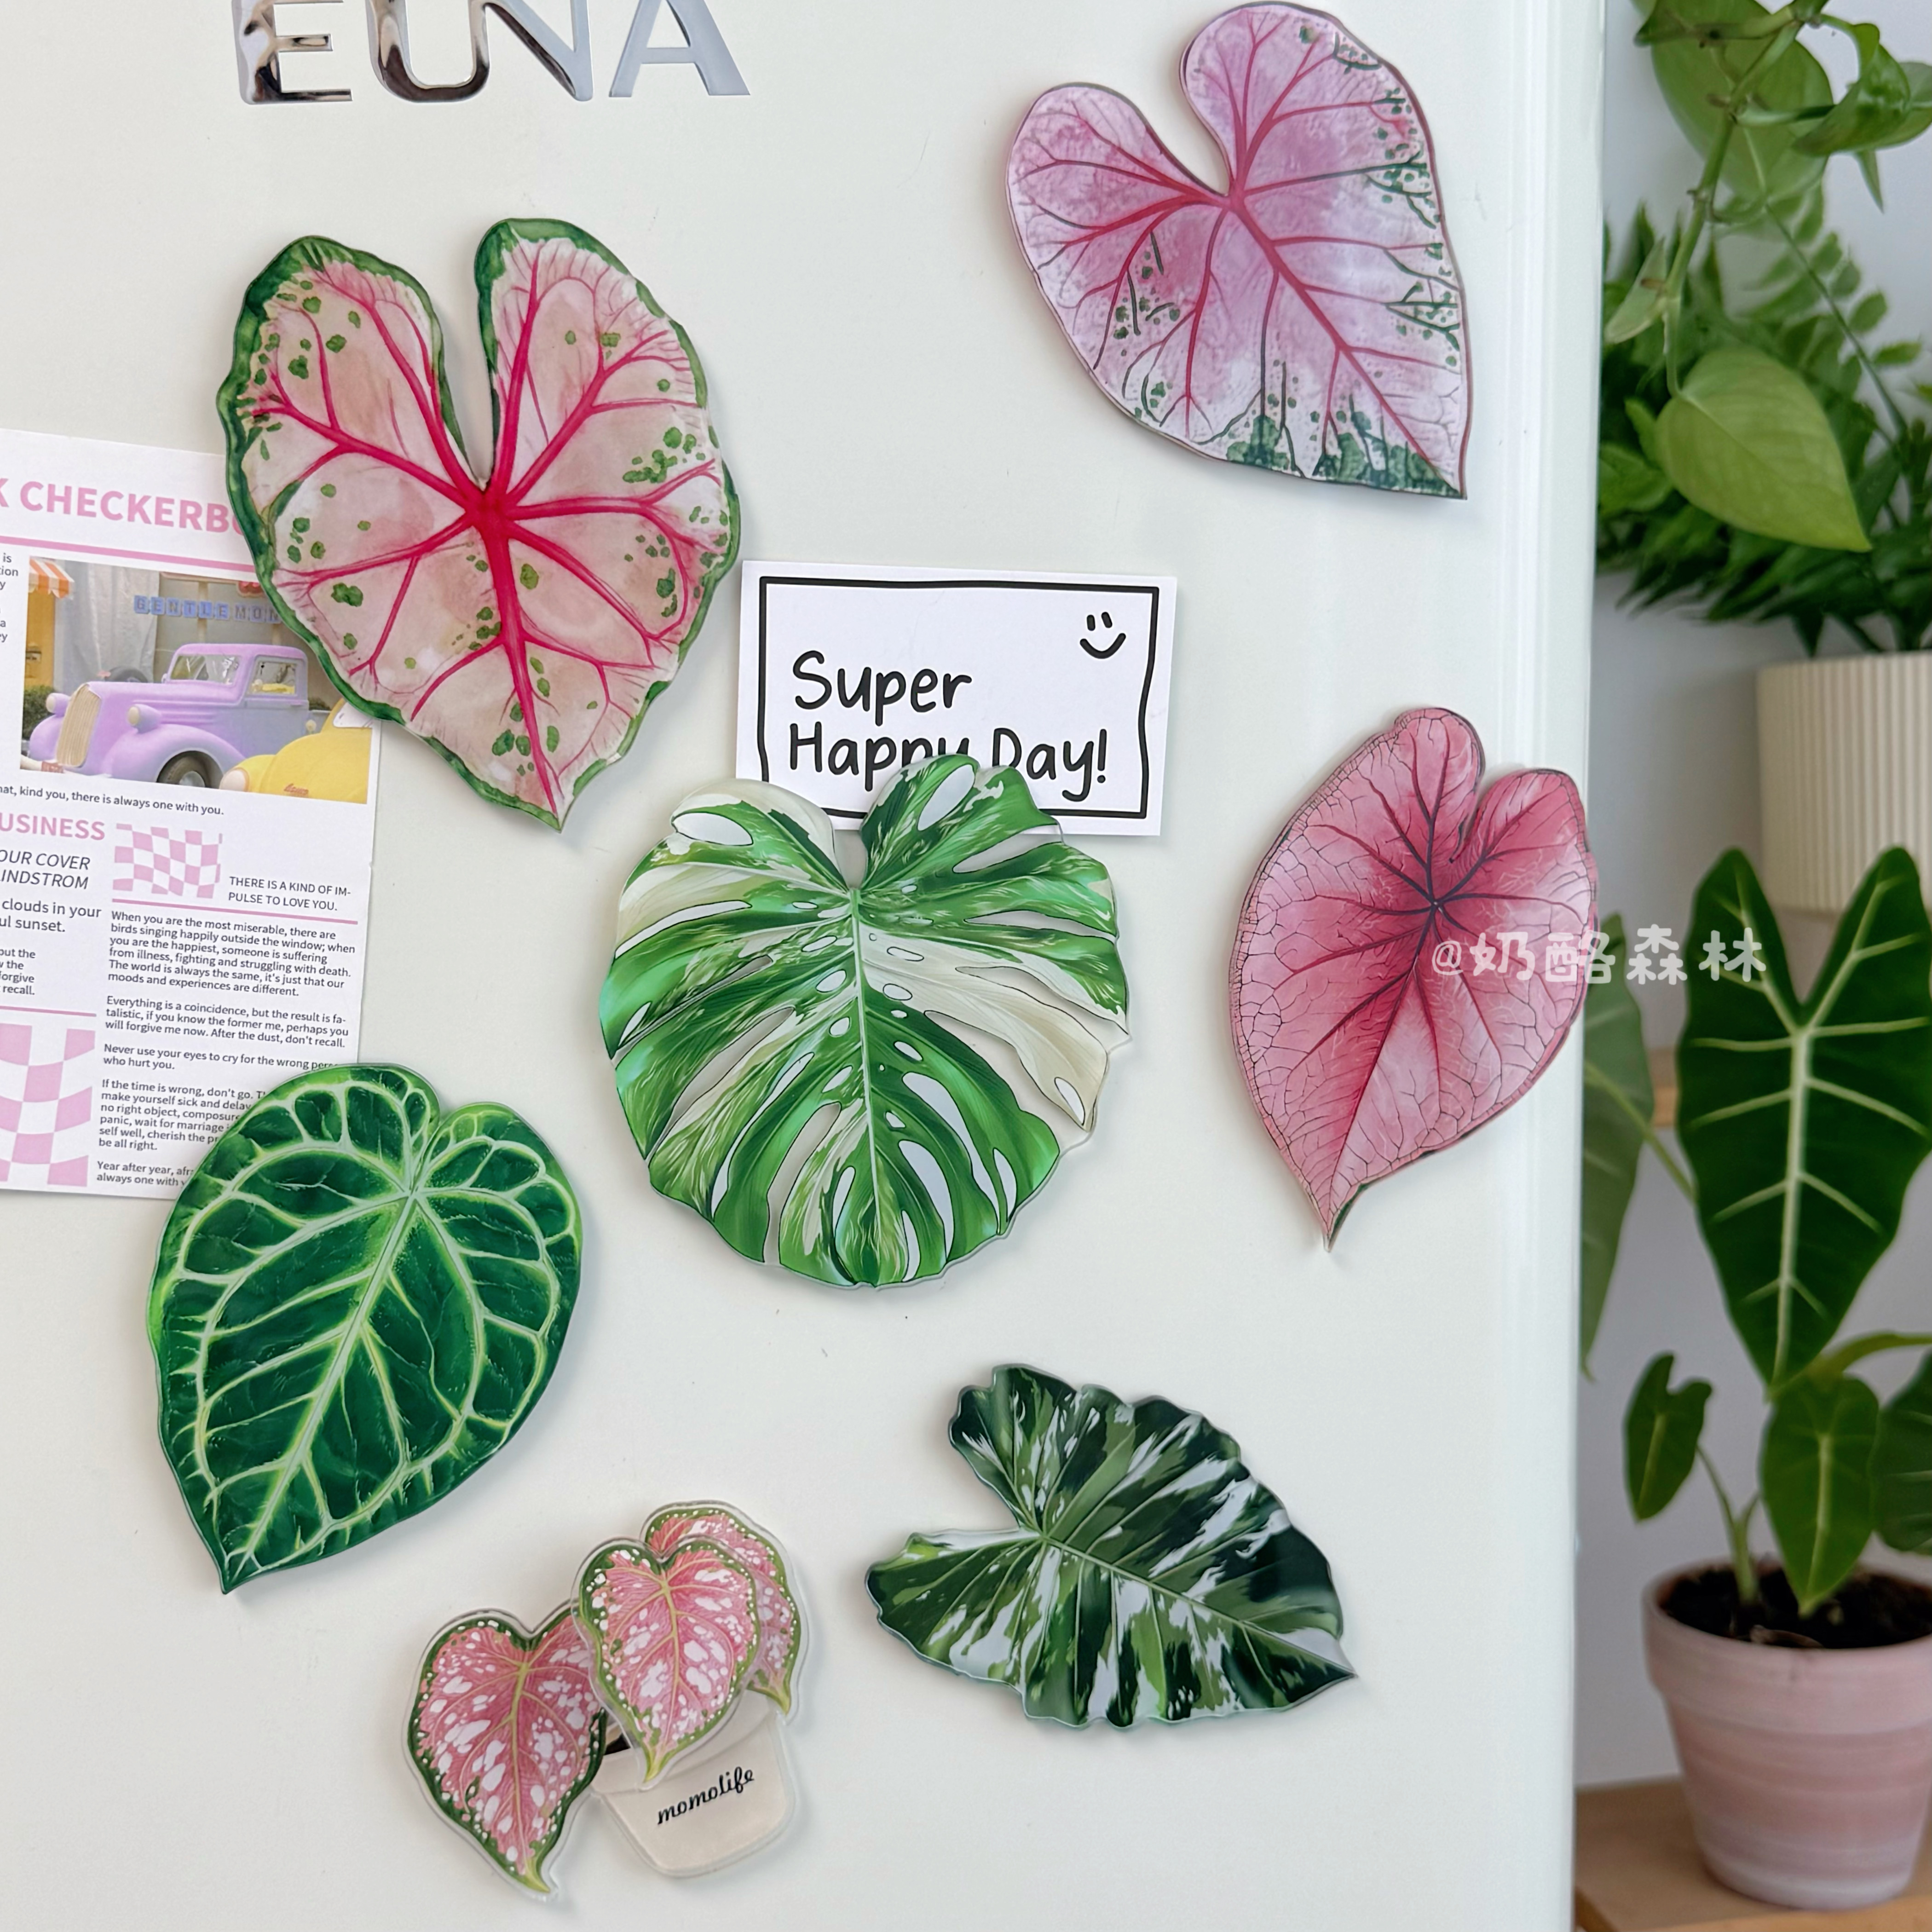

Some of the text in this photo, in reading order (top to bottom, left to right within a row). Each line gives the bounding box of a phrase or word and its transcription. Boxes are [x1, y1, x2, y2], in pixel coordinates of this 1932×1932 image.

[792, 650, 972, 726] Super
[992, 728, 1107, 802] Day!
[20, 786, 224, 815] kind you, there is always one with you.
[35, 853, 91, 871] COVER
[0, 869, 89, 890] INDSTROM
[229, 876, 351, 896] THERE IS A KIND OF IM-
[2, 898, 102, 918] clouds in your
[228, 892, 337, 911] PULSE TO LOVE YOU.
[15, 919, 65, 932] sunset.
[111, 911, 141, 922] When
[143, 916, 163, 925] you
[185, 917, 202, 928] the
[204, 921, 231, 930] most
[233, 922, 287, 937] miserable,
[290, 927, 317, 938] there
[111, 923, 355, 953] birds singing happily outside the window; when
[110, 937, 328, 965] you are the happiest, someone is suffering
[110, 946, 351, 977] from illness, fighting and struggling with death.
[109, 959, 129, 970] The
[131, 963, 161, 972] world
[164, 964, 172, 974] is
[174, 965, 210, 978] always
[212, 968, 230, 978] the
[231, 972, 262, 983] same,
[265, 973, 280, 983] it's
[281, 974, 301, 986] just
[304, 976, 325, 987] that
[3, 985, 35, 995] recall.
[108, 974, 144, 983] moods
[146, 976, 167, 985] and
[169, 979, 231, 991] experiences
[252, 984, 299, 996] different.
[107, 995, 162, 1011] Everything
[165, 1000, 173, 1009] is
[184, 1003, 249, 1018] coincidence,
[252, 1007, 269, 1018] but
[272, 1009, 288, 1019] the
[291, 1012, 320, 1022] result
[322, 1013, 330, 1023] is
[333, 1014, 346, 1024] fa-
[106, 1008, 349, 1037] talistic, if you know the former me, perhaps you
[105, 1020, 123, 1030] will
[126, 1021, 162, 1033] forgive
[183, 1028, 208, 1037] now.
[210, 1028, 236, 1038] After
[238, 1031, 255, 1040] the
[257, 1032, 283, 1044] dust,
[285, 1034, 313, 1045] don't
[315, 1038, 345, 1048] recall.
[103, 1055, 175, 1070] who hurt you.
[104, 1044, 135, 1054] Never
[157, 1050, 182, 1059] your
[183, 1052, 207, 1061] eyes
[209, 1052, 220, 1061] to
[222, 1055, 239, 1065] cry
[241, 1054, 255, 1064] for
[257, 1055, 275, 1066] the
[276, 1059, 309, 1070] wrong
[101, 1092, 220, 1108] make yourself sick and
[102, 1078, 110, 1088] If
[111, 1080, 129, 1090] the
[131, 1081, 156, 1091] time
[157, 1083, 166, 1092] is
[168, 1086, 205, 1097] wrong,
[207, 1087, 235, 1098] don't
[237, 1091, 253, 1101] go.
[116, 1104, 142, 1115] right
[144, 1106, 180, 1119] object,
[99, 1126, 119, 1136] self
[120, 1128, 145, 1140] well,
[147, 1130, 185, 1141] cherish
[188, 1132, 205, 1142] the
[100, 1115, 132, 1127] panic,
[134, 1118, 157, 1127] wait
[160, 1118, 175, 1129] for
[177, 1122, 224, 1134] marriage
[99, 1137, 157, 1151] be all right.
[97, 1161, 121, 1171] Year
[122, 1162, 147, 1172] after
[149, 1166, 174, 1176] year,
[97, 1172, 132, 1185] always
[156, 1177, 179, 1186] with
[657, 1766, 755, 1825] momolife
